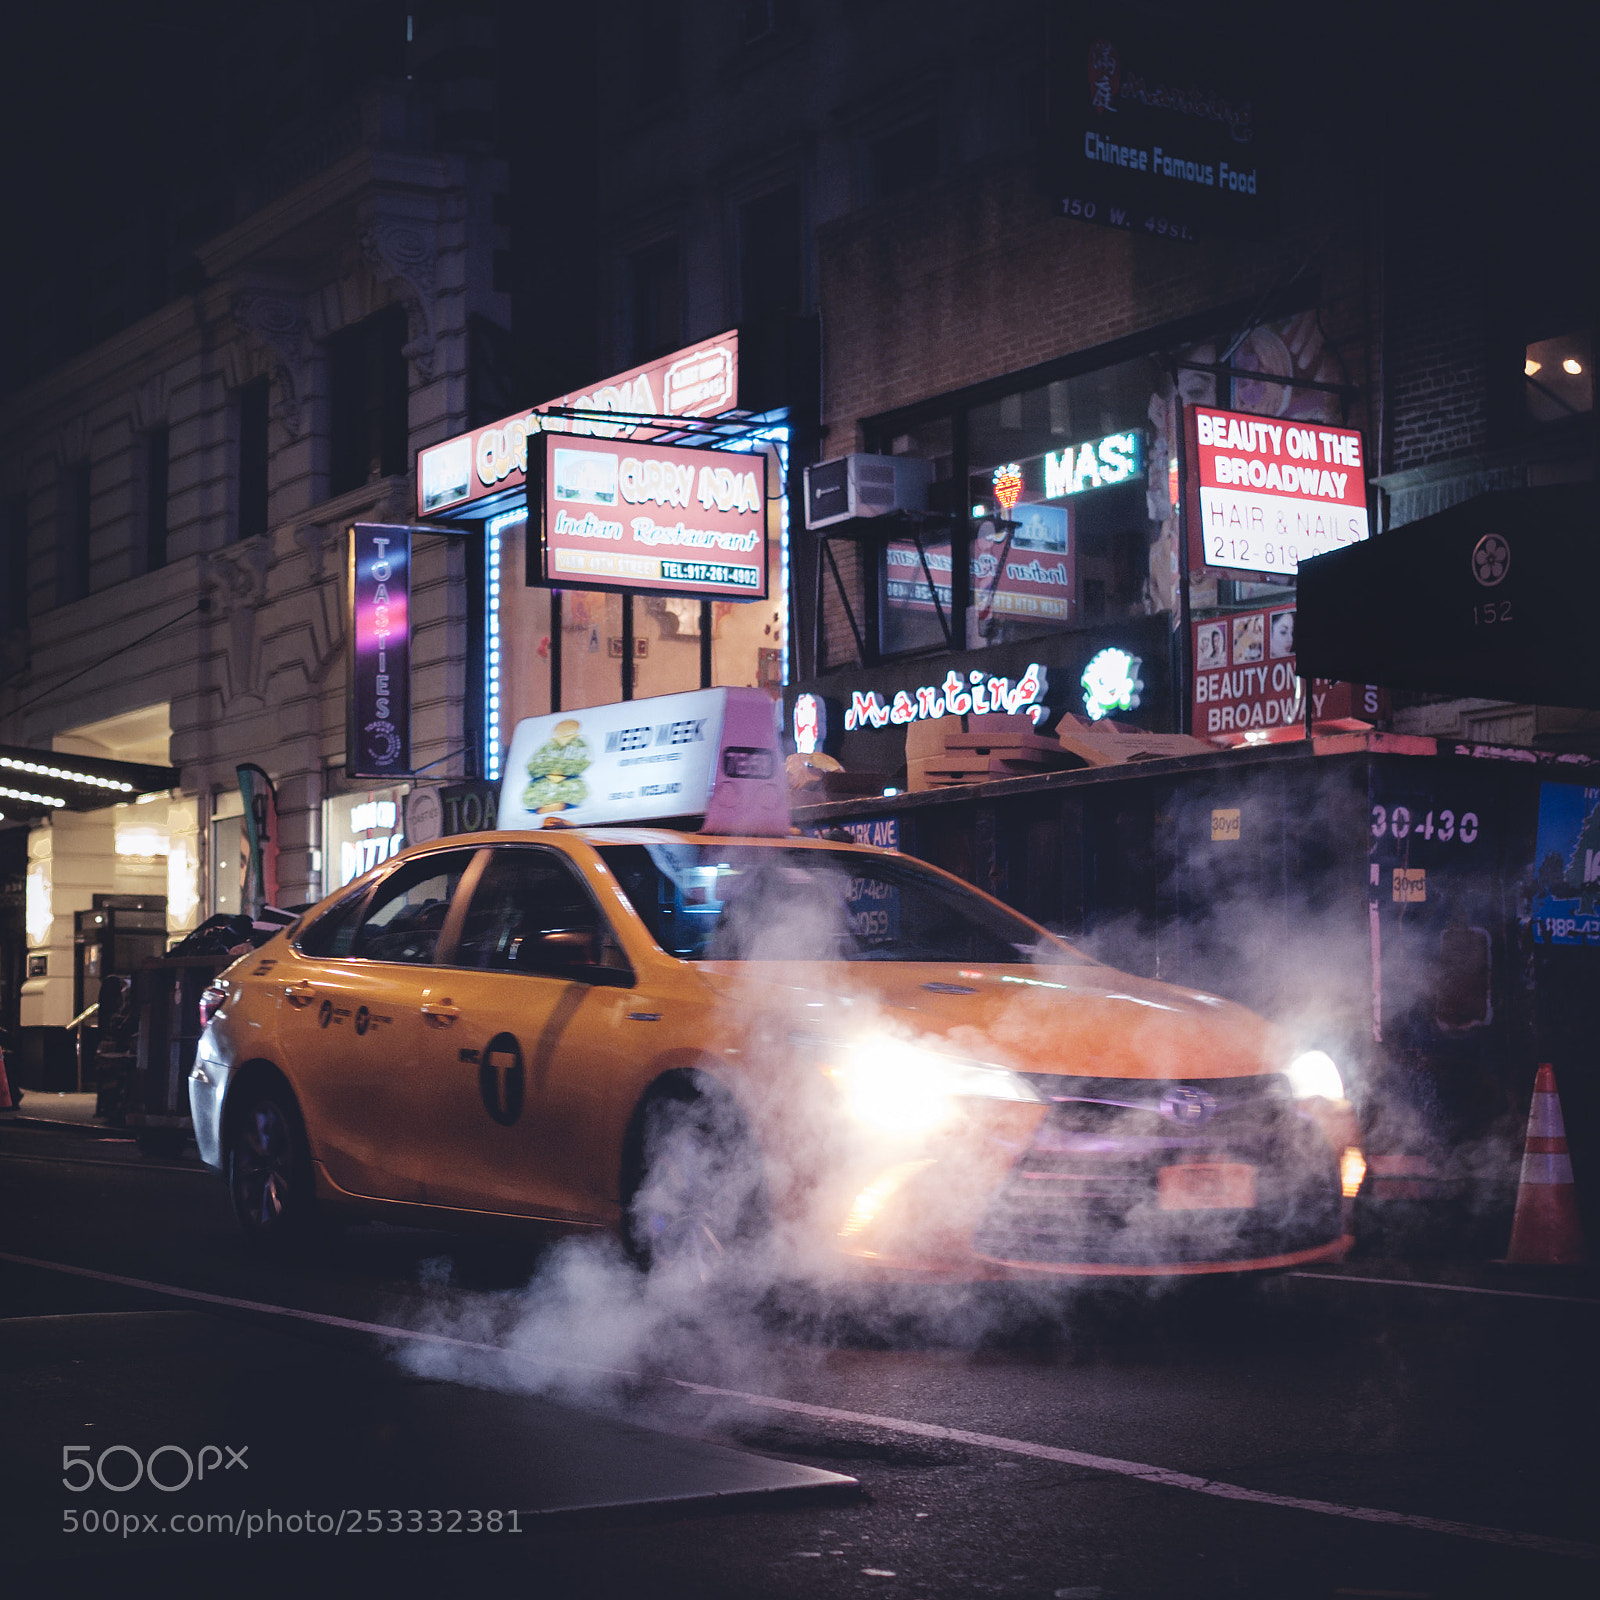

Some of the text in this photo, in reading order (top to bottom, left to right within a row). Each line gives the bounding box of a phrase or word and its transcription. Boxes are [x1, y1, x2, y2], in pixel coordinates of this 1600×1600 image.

[1083, 130, 1257, 196] Chinese Famous Food
[1061, 197, 1097, 220] 150
[1197, 414, 1361, 467] BEAUTY ON THE
[618, 458, 761, 513] CURRY INDIA
[1214, 455, 1348, 499] BROADWAY
[555, 509, 760, 552] Indian Restaurant
[1210, 500, 1361, 545] HAIR & NAILS
[371, 538, 391, 720] TOASTIES
[1472, 601, 1513, 626] 152
[845, 663, 1043, 731] Manting
[1195, 665, 1269, 704] BEAUTY
[1271, 662, 1297, 693] ON
[872, 820, 897, 846] AVE
[1212, 816, 1240, 834] 30yd
[1393, 876, 1426, 894] 30yd
